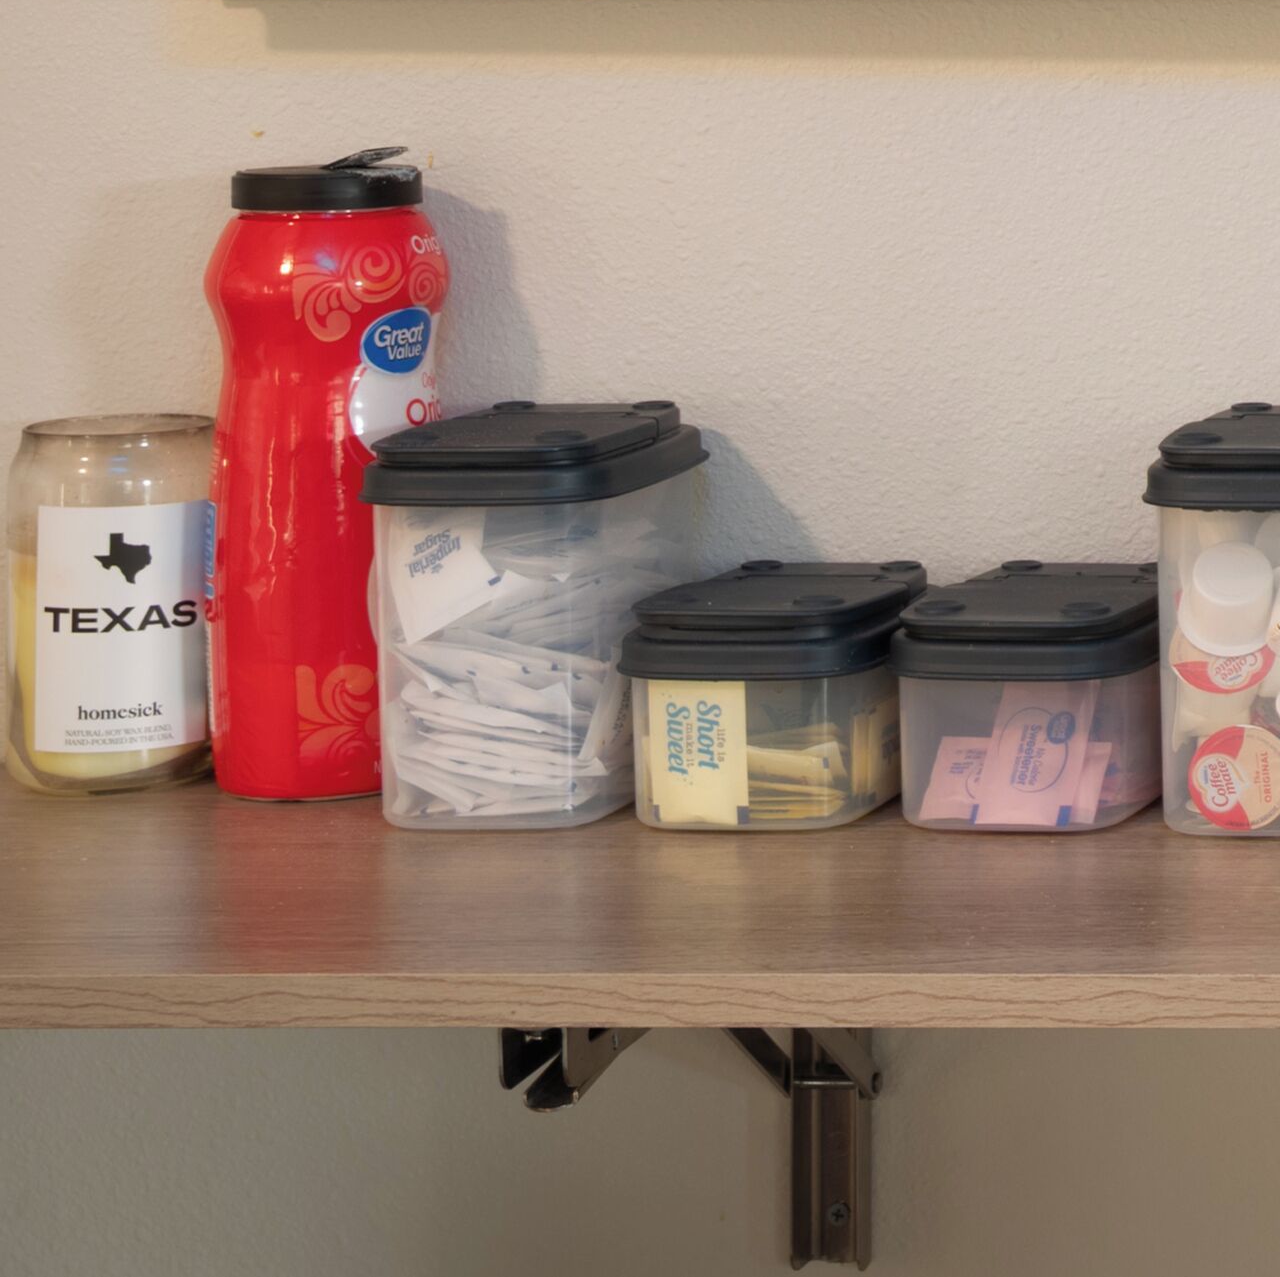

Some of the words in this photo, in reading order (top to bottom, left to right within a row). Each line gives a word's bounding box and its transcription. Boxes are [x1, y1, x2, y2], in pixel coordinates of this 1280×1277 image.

[374, 322, 425, 348] Great
[387, 343, 423, 361] Value
[413, 528, 451, 556] Sugar
[44, 600, 197, 633] TEXAS
[78, 702, 162, 720] homesick
[666, 701, 691, 777] Sweet
[685, 723, 695, 758] make
[697, 700, 721, 771] Short
[716, 727, 726, 749] life
[1016, 723, 1040, 787] Sweetener
[1208, 763, 1229, 808] Coffee
[1216, 760, 1237, 795] mate
[1261, 751, 1273, 804] ORIGINAL
